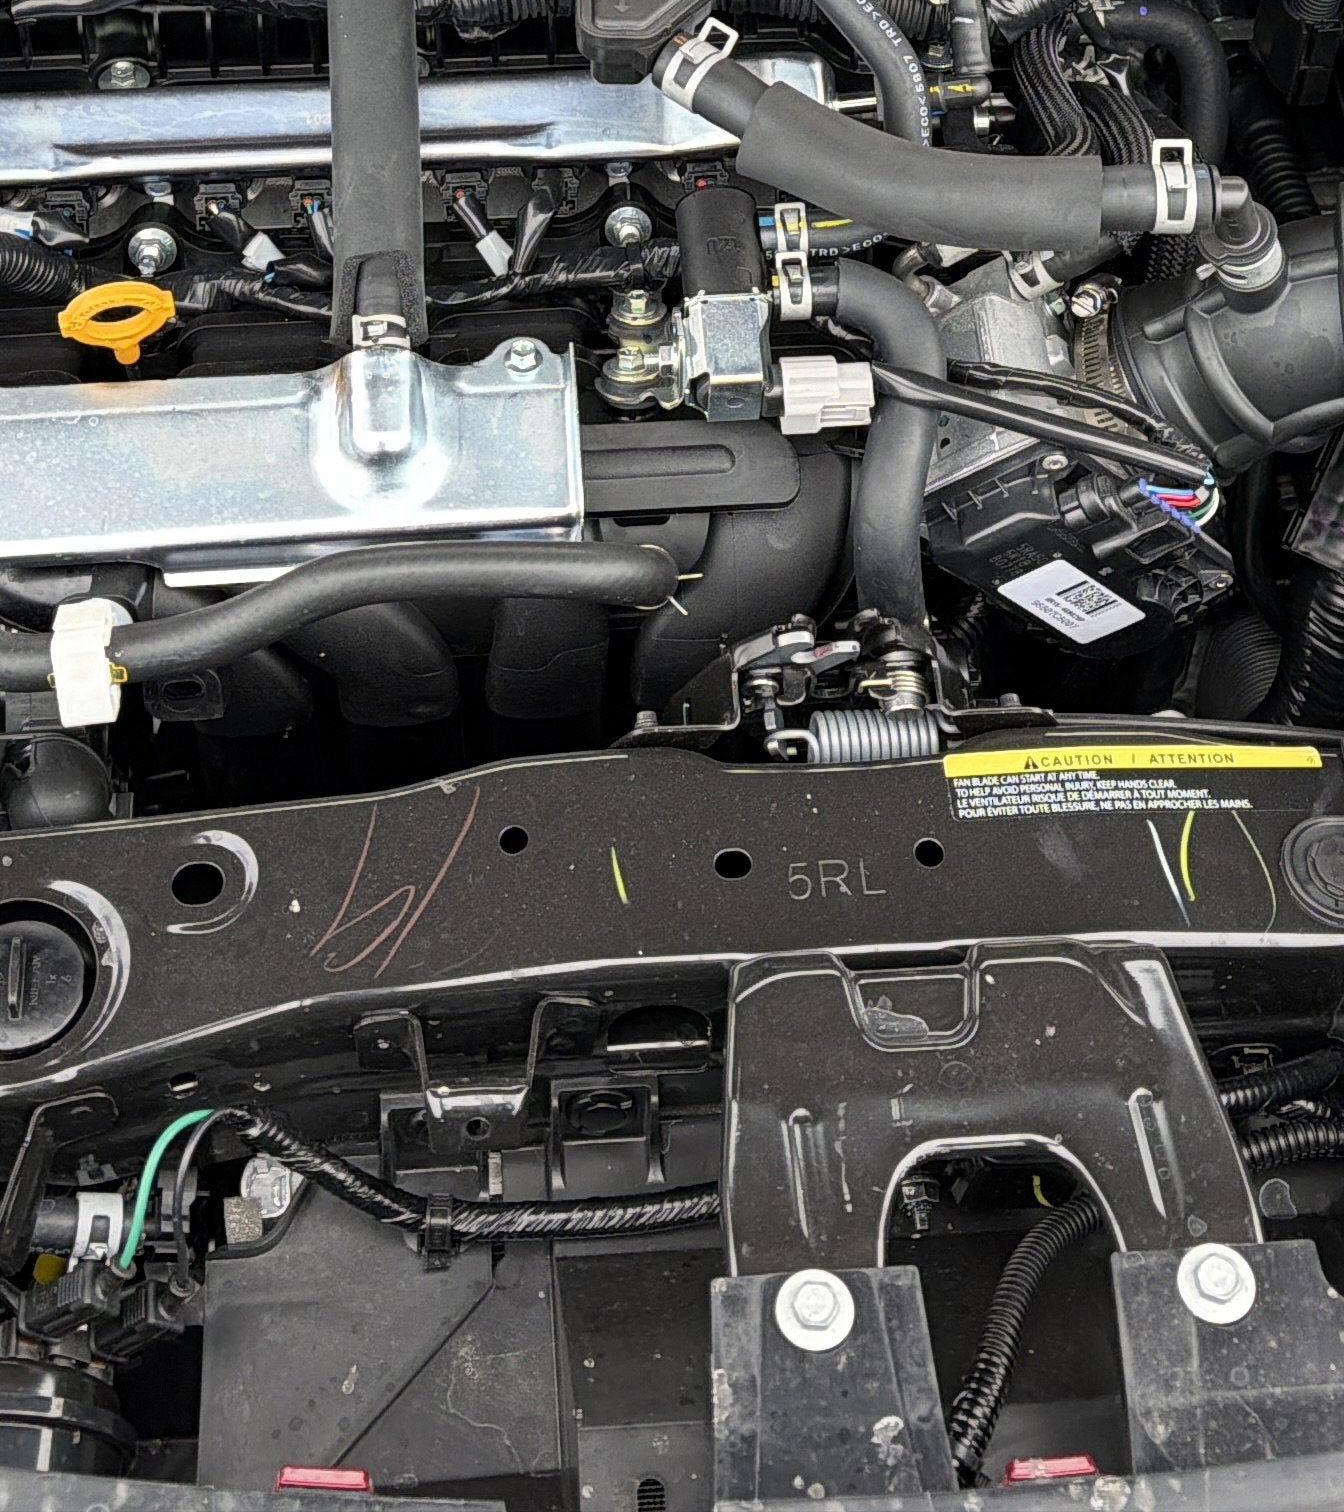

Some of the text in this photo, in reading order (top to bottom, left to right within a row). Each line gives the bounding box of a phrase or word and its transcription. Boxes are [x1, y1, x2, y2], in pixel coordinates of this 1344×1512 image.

[1041, 754, 1113, 767] CAUTION
[1149, 753, 1234, 765] ATTENTION
[954, 776, 971, 787] FAN
[971, 775, 999, 786] BLADE
[1000, 774, 1019, 785] CAN
[1020, 773, 1045, 783] START
[1047, 772, 1058, 782] AT
[956, 788, 968, 798] TO
[969, 786, 991, 797] HELP
[992, 785, 1018, 796] AVOID
[1019, 783, 1064, 794] PERSONAL
[1097, 781, 1117, 790] KEEP
[1117, 779, 1148, 790] HANDS
[957, 798, 969, 809] LE
[969, 795, 1031, 807] VENTILATEUR
[1032, 793, 1066, 804] RISQUE
[1067, 791, 1081, 801] DE
[1082, 789, 1132, 801] DÉMARRER
[1142, 789, 1166, 799] TOUT
[1166, 789, 1212, 799] MOMENT.
[959, 798, 1254, 819] POUR ÉVITER TOUTE BLESSURE, NE PAS EN APPROCHER LES MAINS.
[786, 858, 888, 902] 5RL
